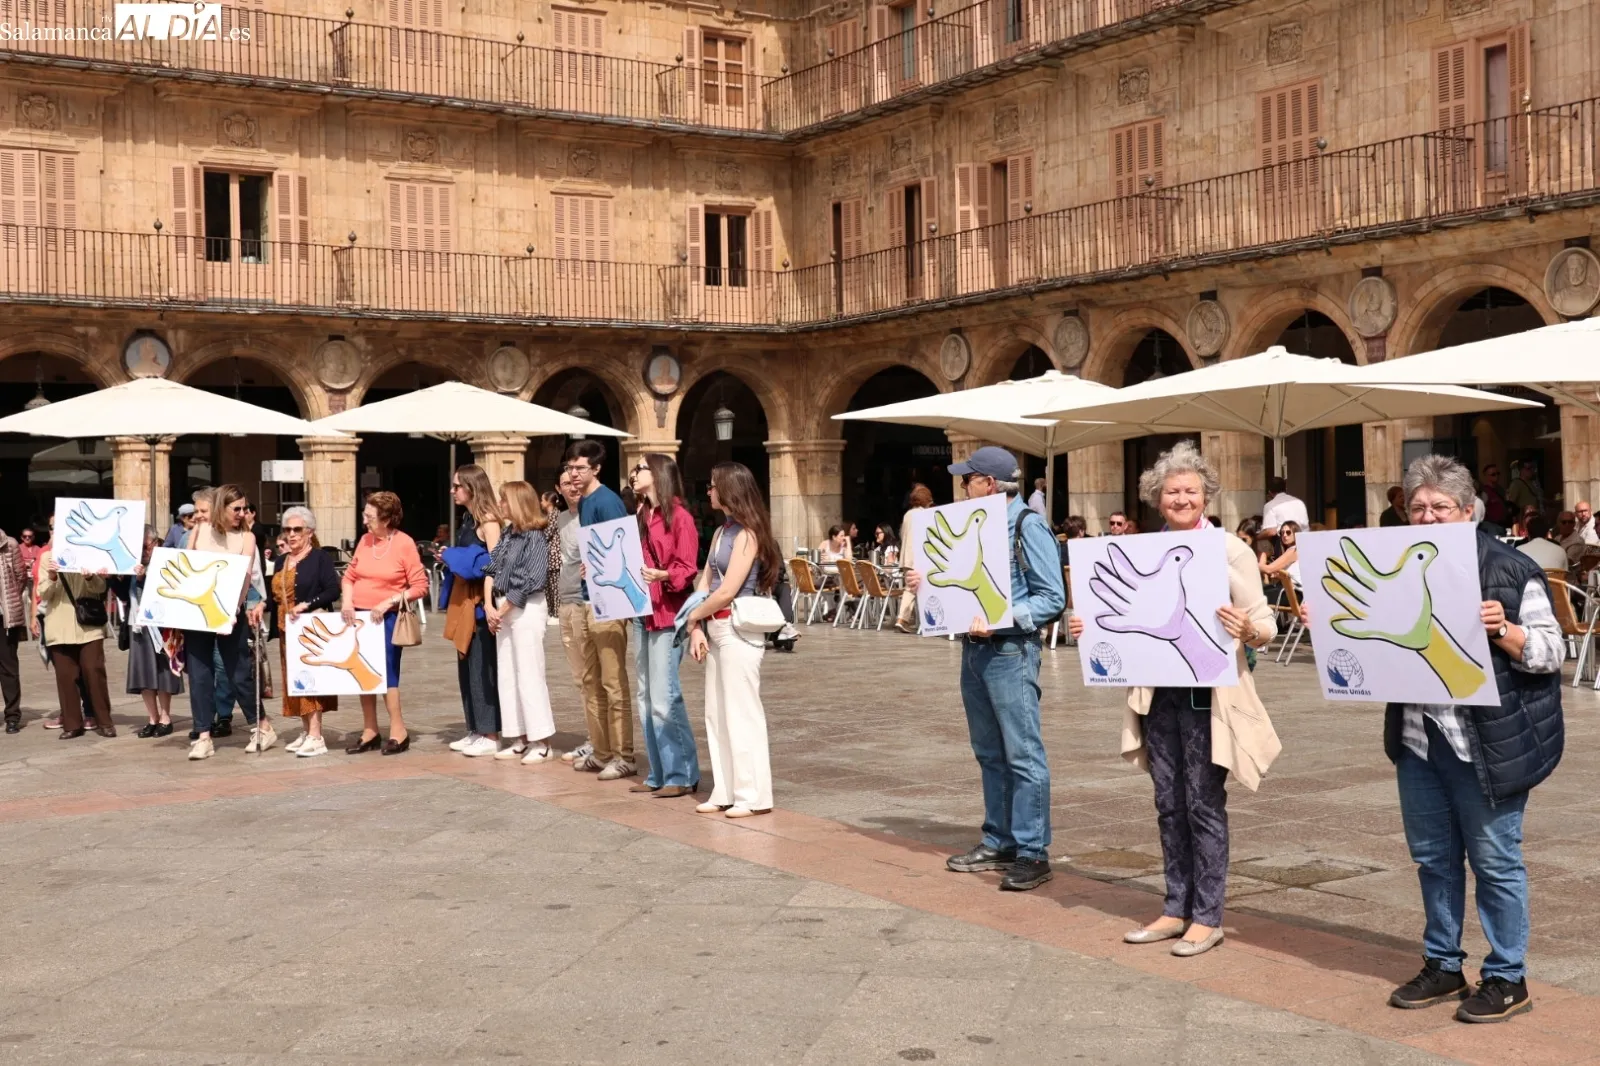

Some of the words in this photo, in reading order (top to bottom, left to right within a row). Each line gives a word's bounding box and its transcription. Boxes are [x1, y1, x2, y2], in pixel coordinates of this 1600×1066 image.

[1108, 676, 1127, 684] Unidas
[1328, 687, 1349, 695] Manos
[1349, 688, 1372, 696] Unidas
